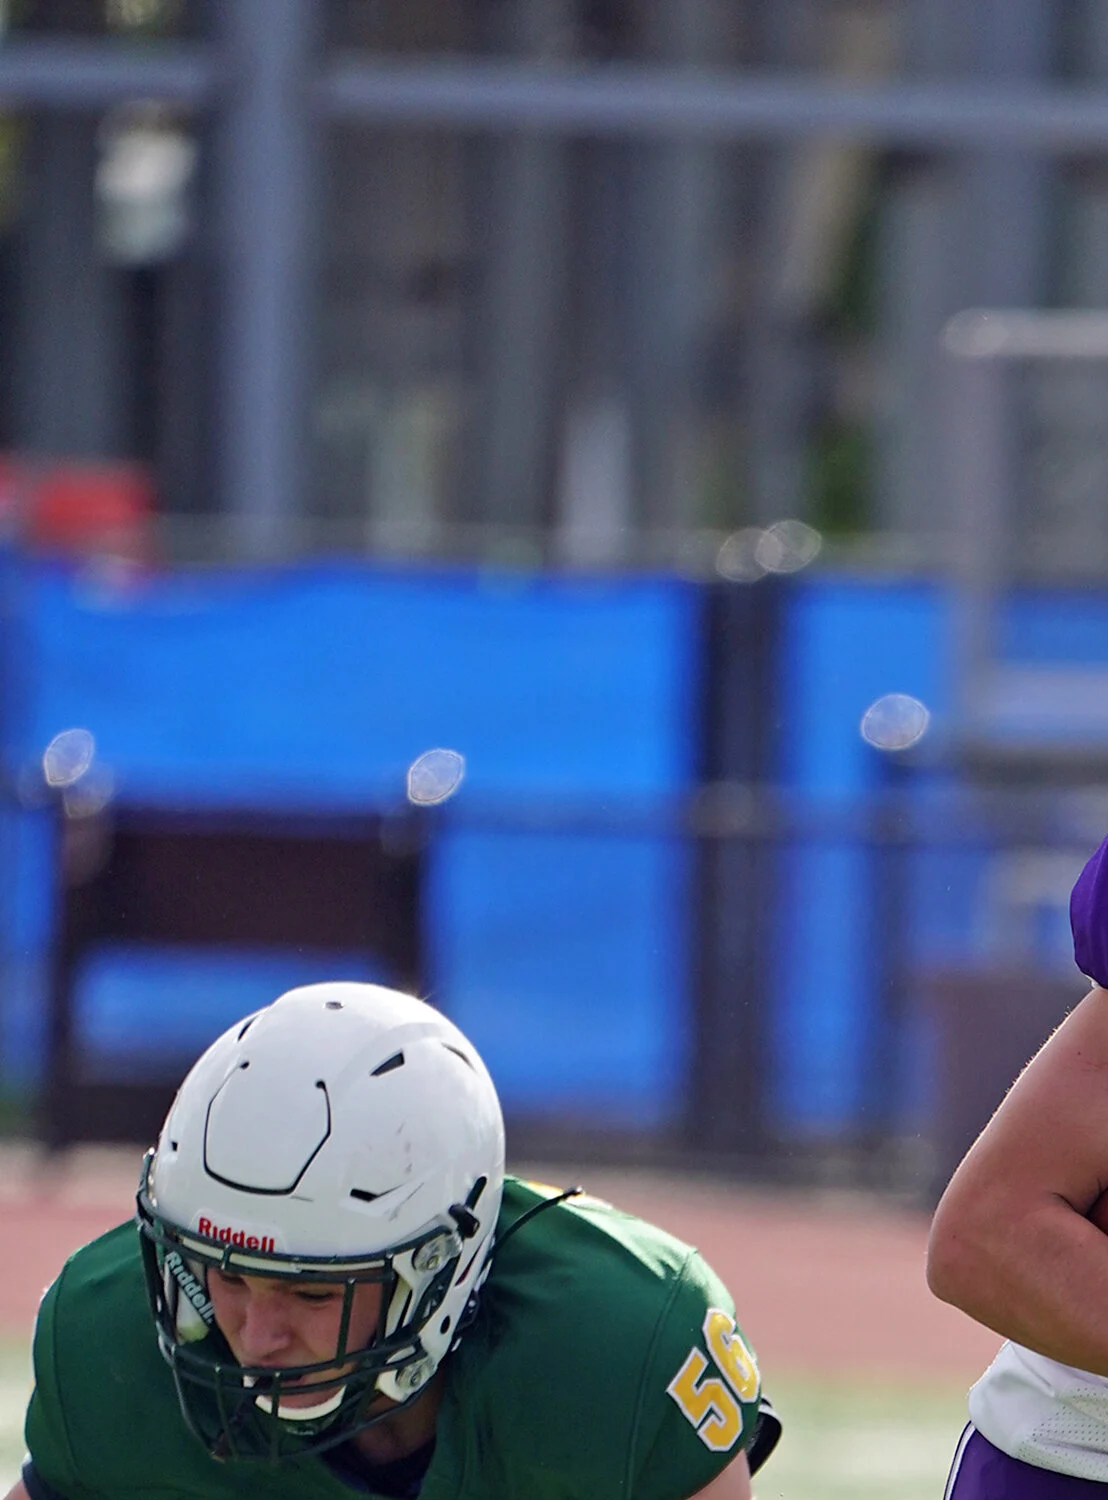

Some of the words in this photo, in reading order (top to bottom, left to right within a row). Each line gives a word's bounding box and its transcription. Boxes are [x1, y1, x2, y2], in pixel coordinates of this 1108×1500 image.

[198, 1217, 275, 1253] Riddell
[165, 1251, 215, 1323] Riddell
[666, 1308, 761, 1451] 56
